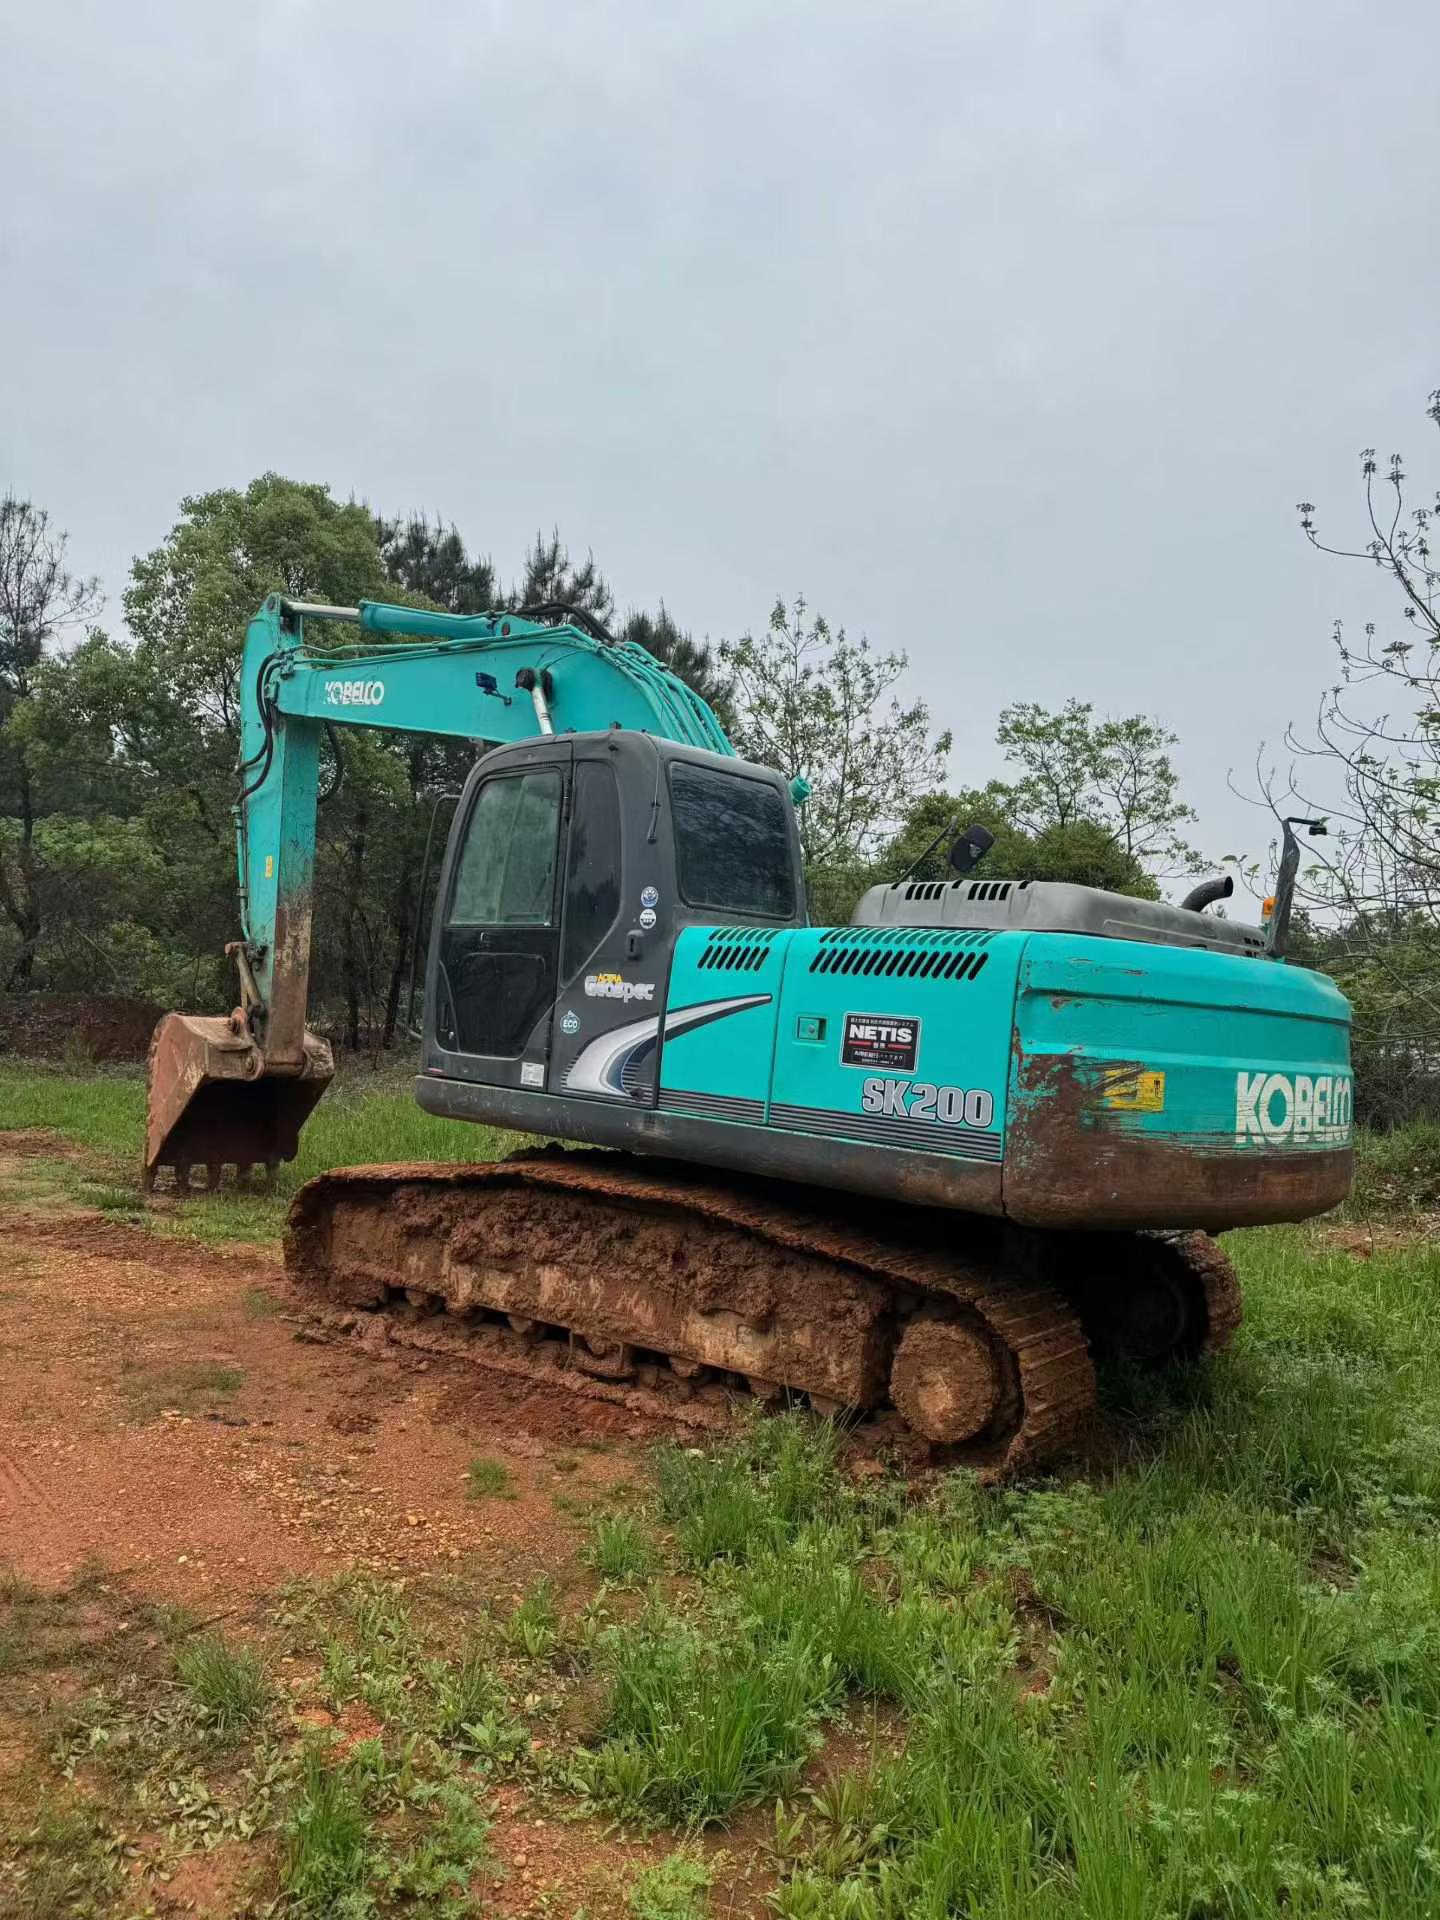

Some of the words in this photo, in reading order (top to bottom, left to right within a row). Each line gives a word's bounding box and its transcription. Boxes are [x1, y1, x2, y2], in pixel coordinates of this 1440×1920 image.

[563, 1019, 578, 1029] ECO
[849, 1024, 912, 1043] NETIS
[862, 1077, 993, 1128] SK200
[1235, 1072, 1351, 1144] KOBELCO
